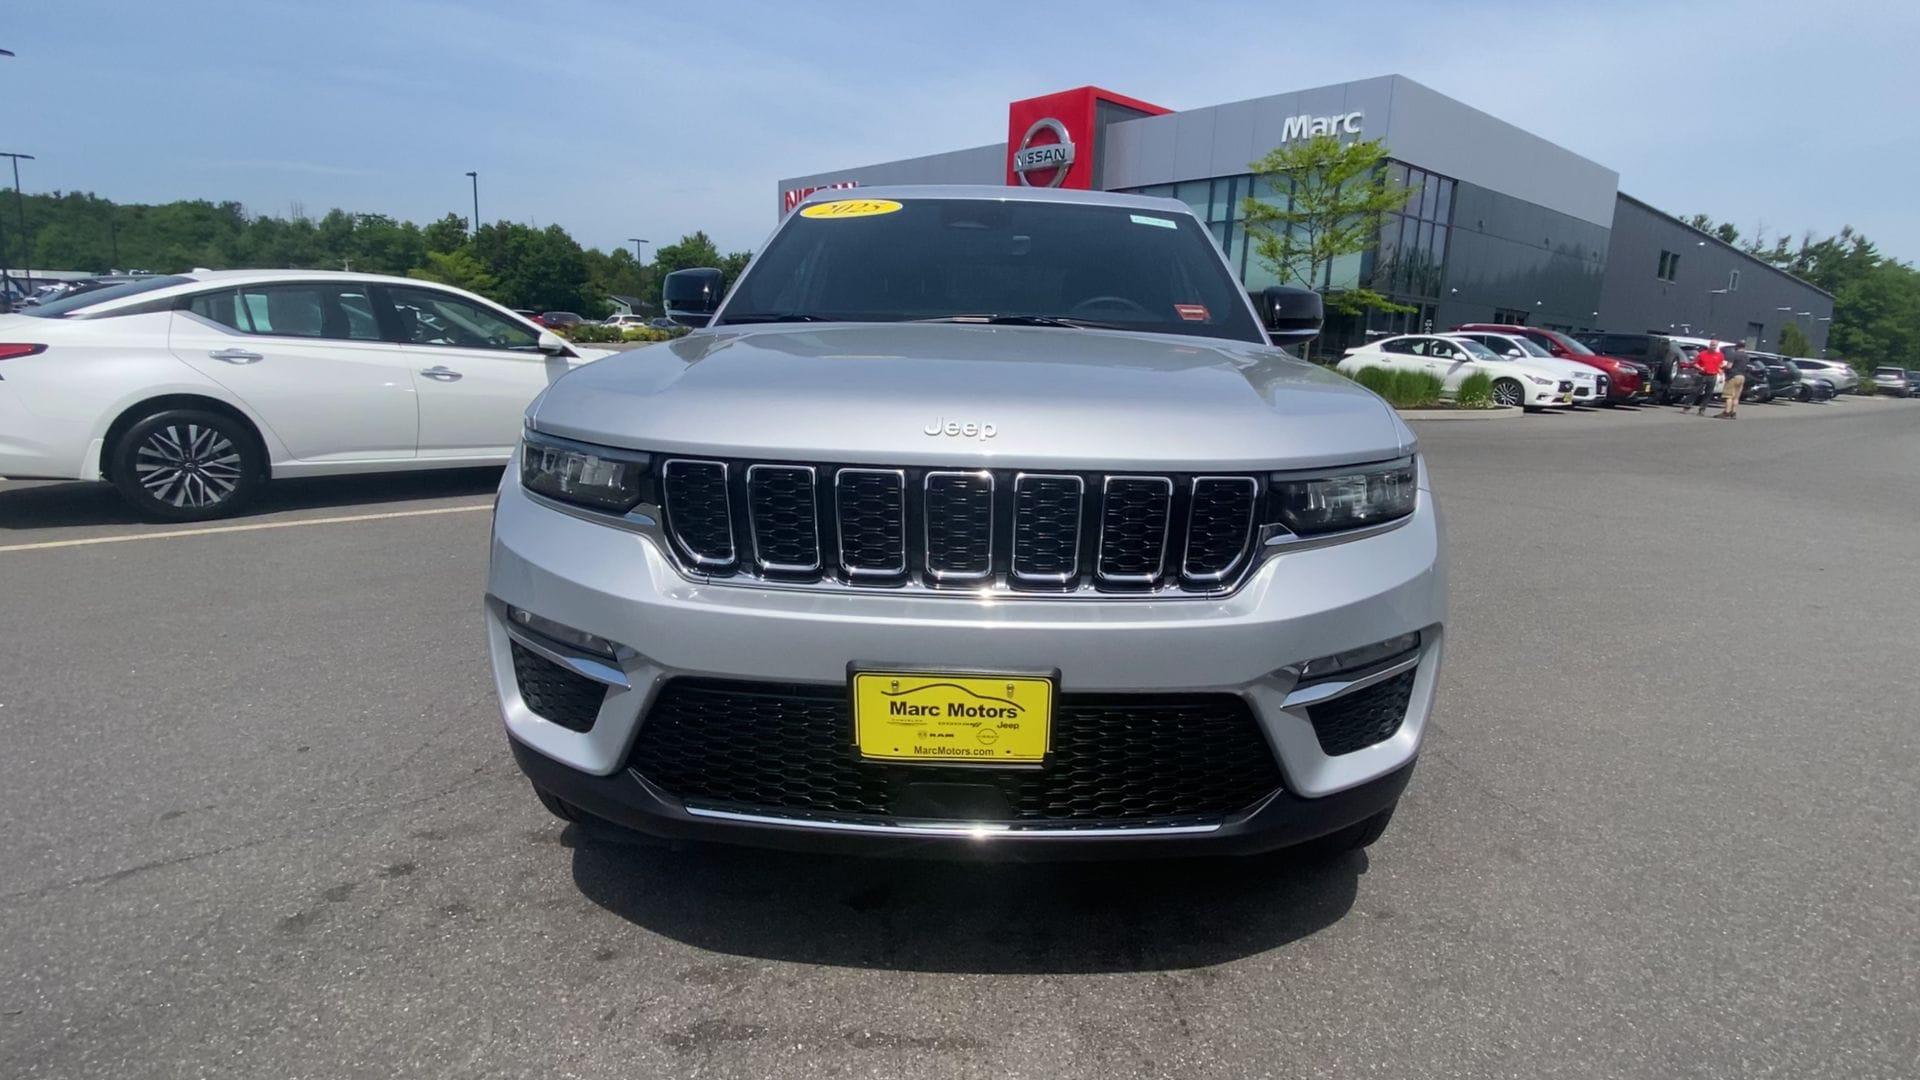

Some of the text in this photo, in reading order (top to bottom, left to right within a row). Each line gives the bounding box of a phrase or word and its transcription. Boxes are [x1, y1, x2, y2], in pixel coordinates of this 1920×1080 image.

[1281, 112, 1362, 142] Marc
[1017, 148, 1066, 167] NISSAN
[923, 415, 998, 441] Jeep
[890, 701, 1018, 719] Marc Motors
[997, 721, 1020, 730] Jeep
[914, 745, 994, 756] MarcMotors.com
